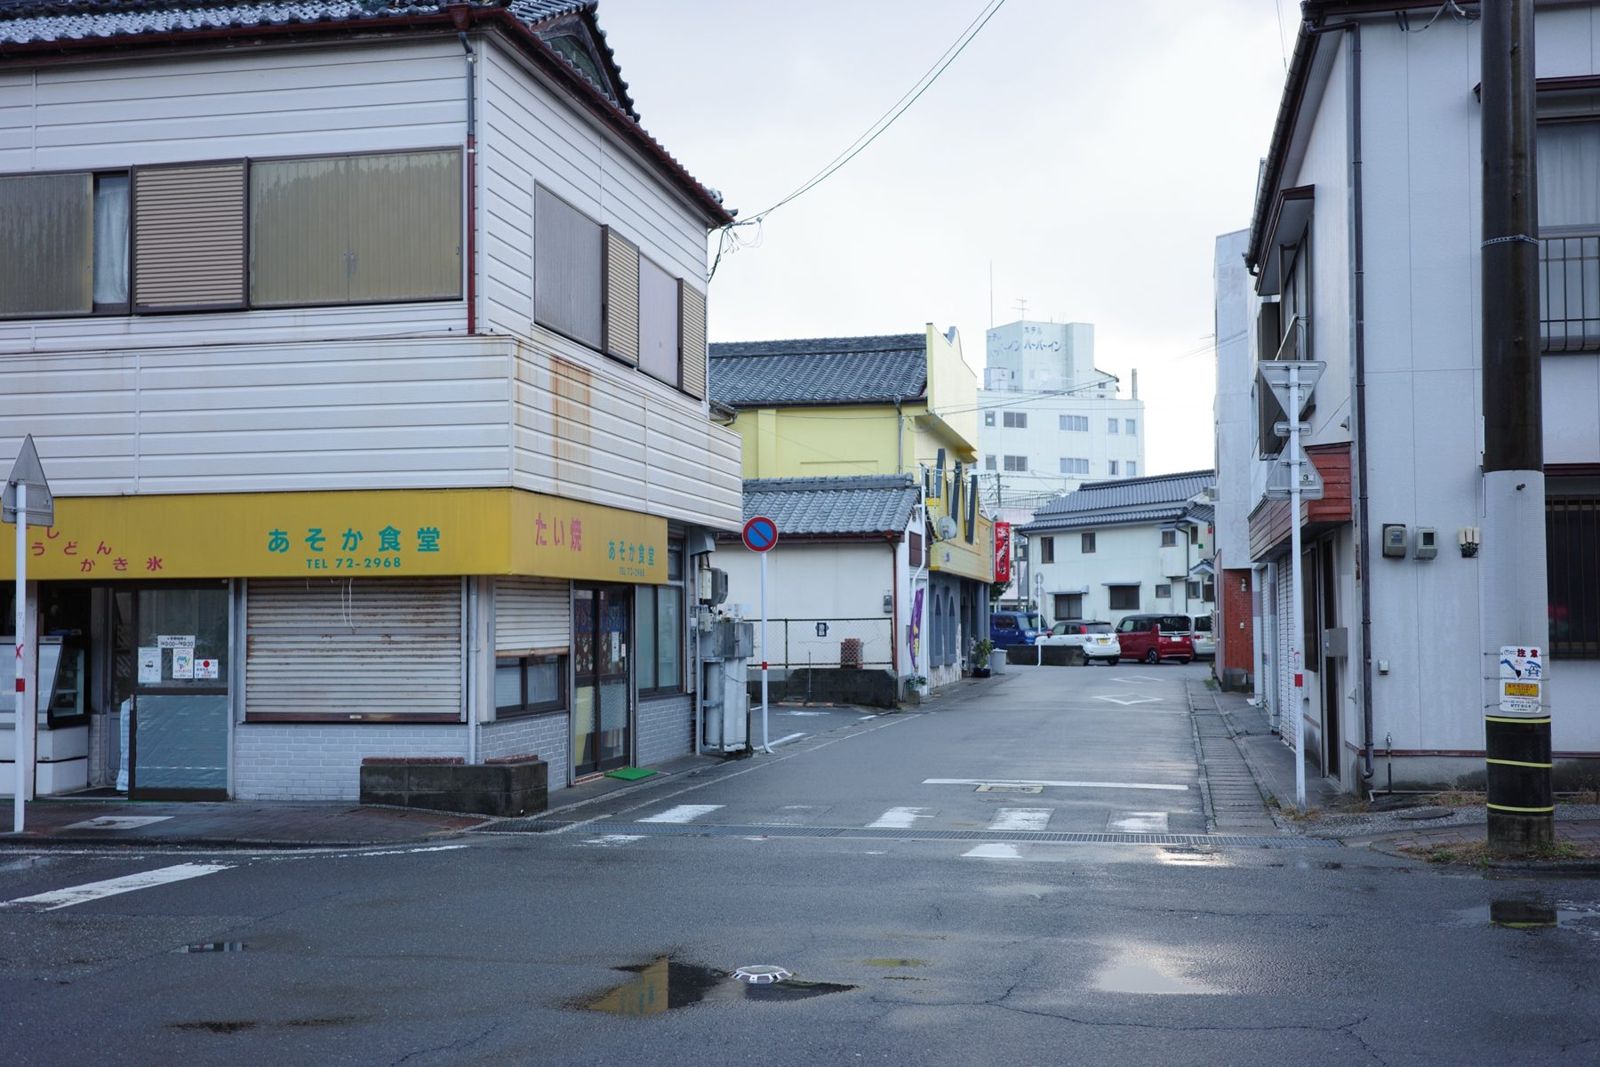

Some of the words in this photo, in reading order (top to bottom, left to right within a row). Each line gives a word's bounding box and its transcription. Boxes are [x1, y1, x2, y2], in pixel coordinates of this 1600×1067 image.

[267, 524, 441, 553] あそか食堂
[535, 511, 583, 552] たい焼
[31, 541, 112, 556] うどん
[608, 540, 655, 566] あそか食堂
[80, 556, 163, 572] かき氷
[306, 558, 329, 569] TEL
[335, 557, 402, 569] 72-2968
[1517, 648, 1539, 658] 注意
